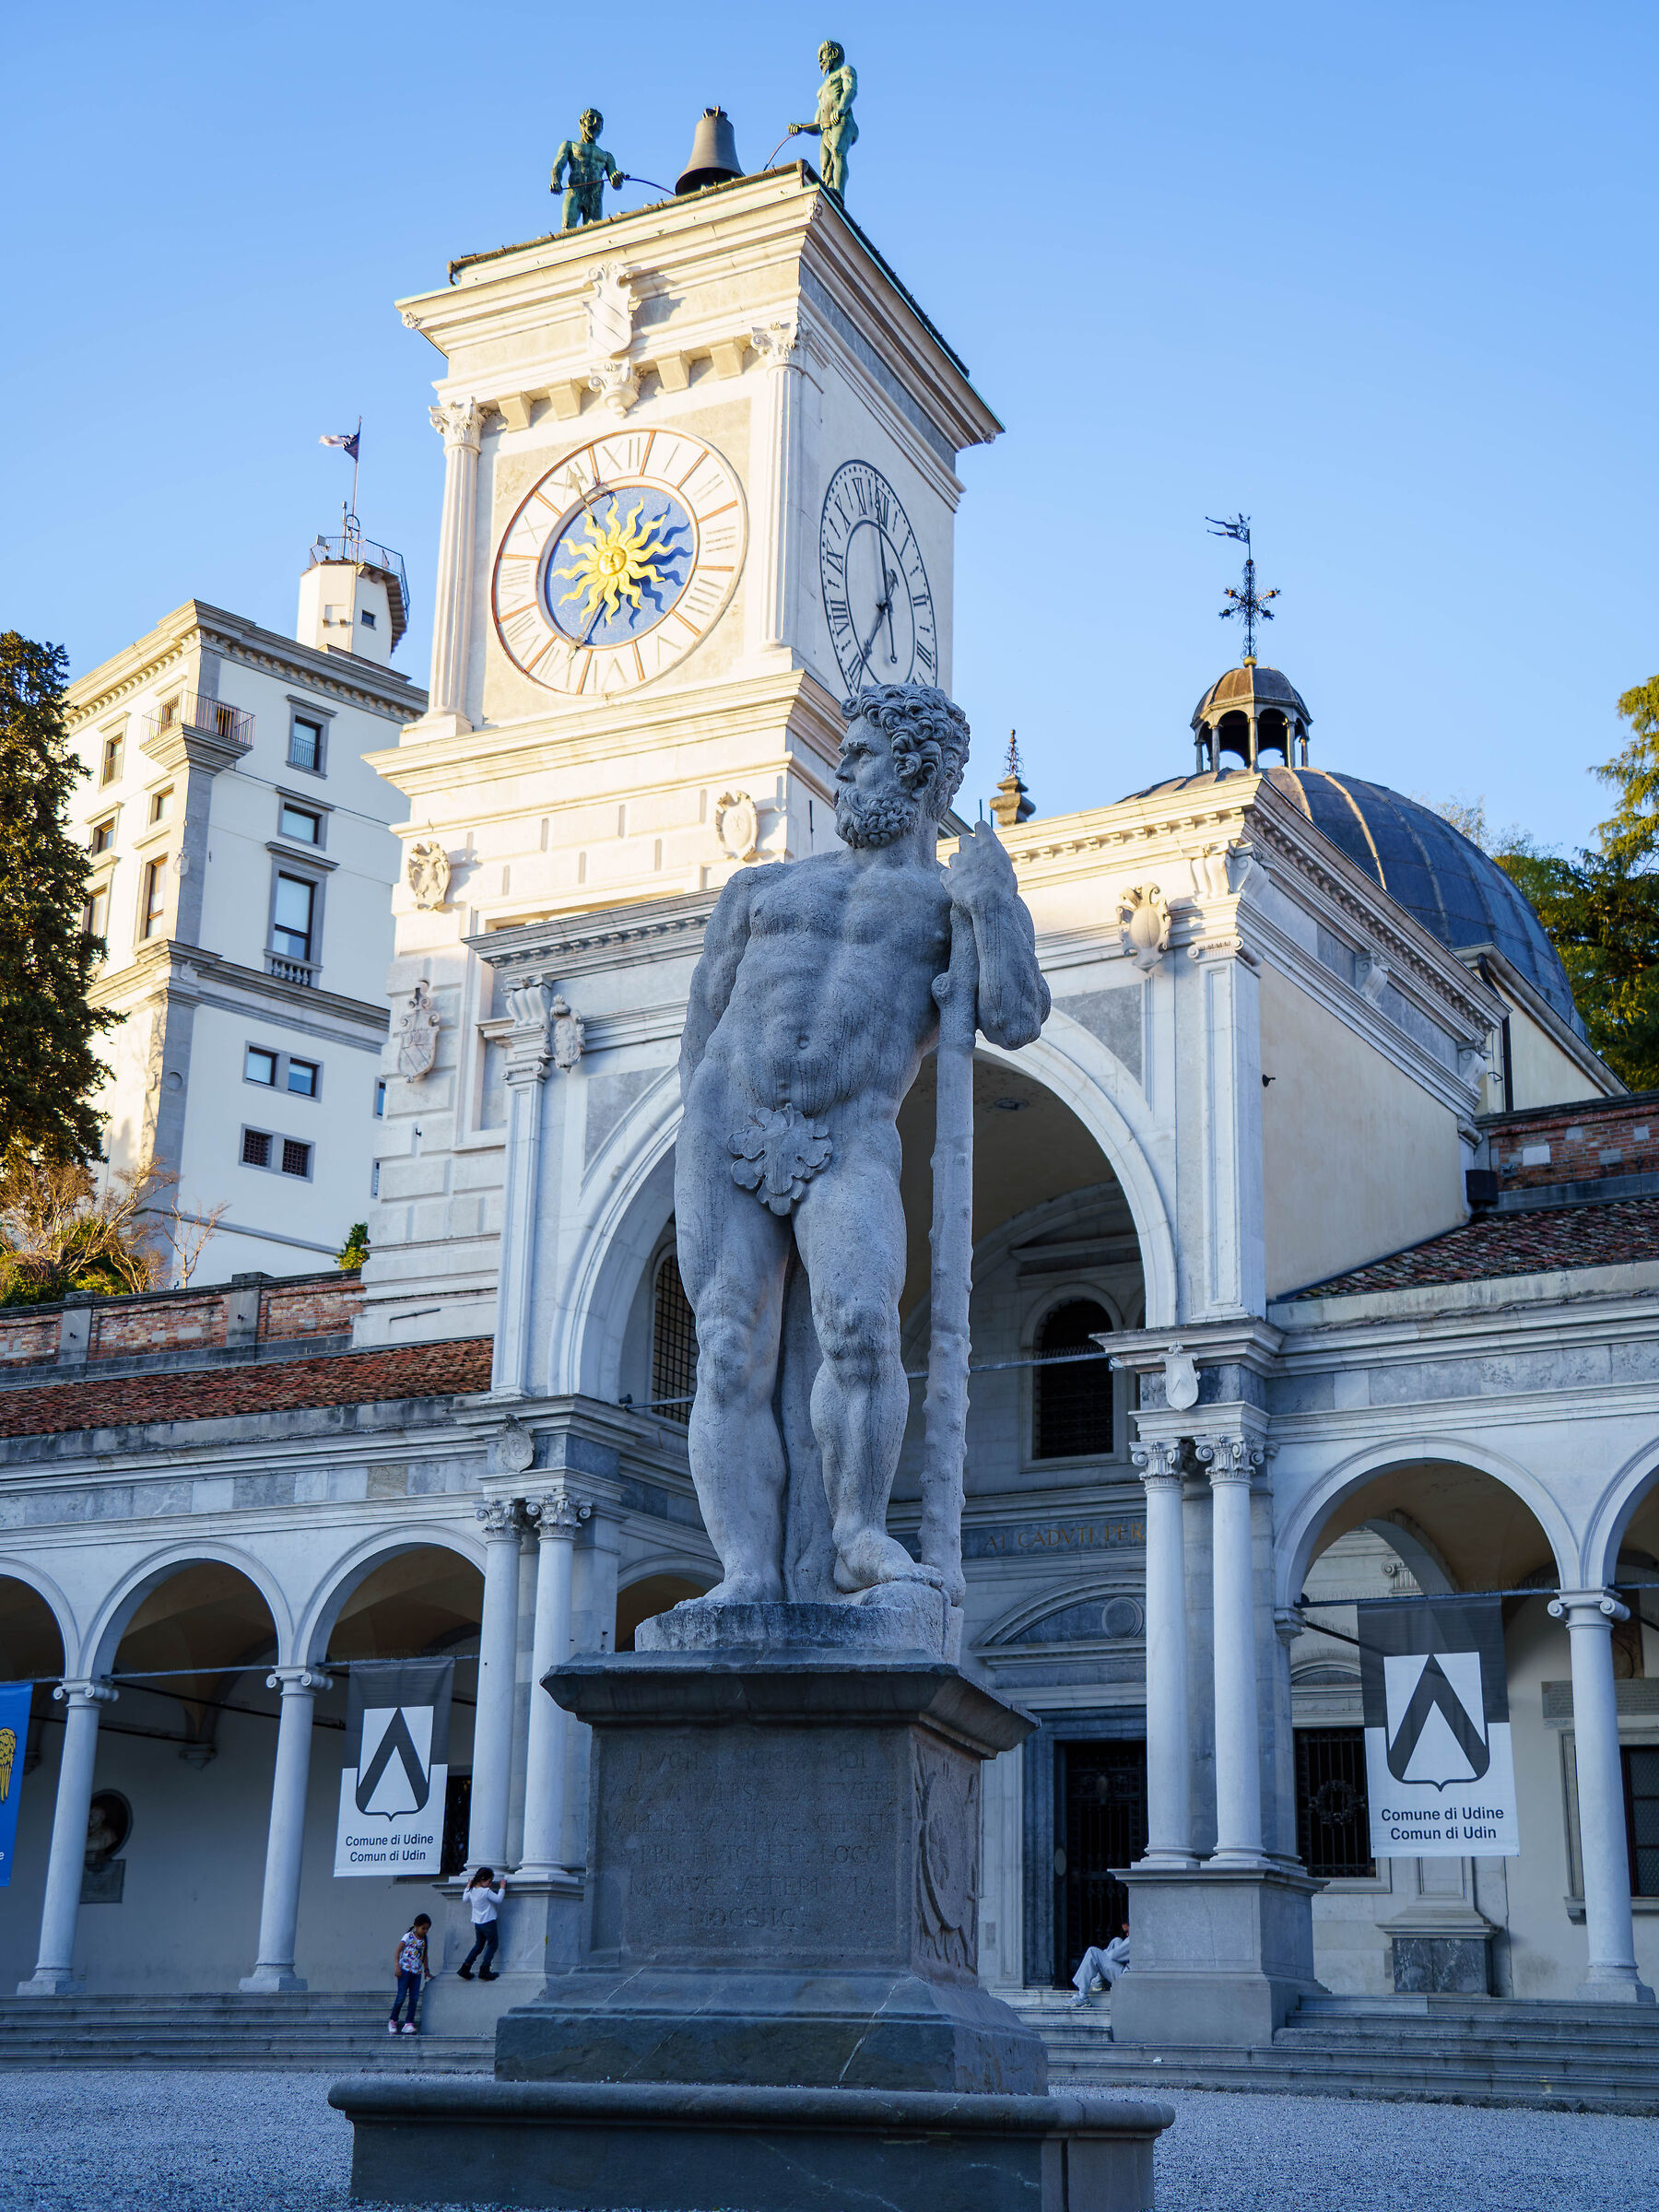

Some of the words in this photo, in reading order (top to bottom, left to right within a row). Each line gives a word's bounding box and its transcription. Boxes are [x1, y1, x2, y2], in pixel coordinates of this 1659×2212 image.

[985, 1533, 1006, 1551] AI
[1018, 1525, 1094, 1548] CADVTI
[1105, 1522, 1145, 1543] PER
[1381, 1807, 1441, 1821] Comune
[1444, 1806, 1457, 1820] di
[1462, 1806, 1504, 1819] Udine
[345, 1835, 388, 1847] Comune
[391, 1834, 401, 1845] di
[403, 1832, 434, 1845] Udine
[1390, 1827, 1441, 1841] Comun
[1445, 1826, 1458, 1840] di
[1463, 1826, 1497, 1839] Udin
[349, 1850, 386, 1863] Comun
[389, 1849, 400, 1862] di
[402, 1848, 426, 1861] Udin
